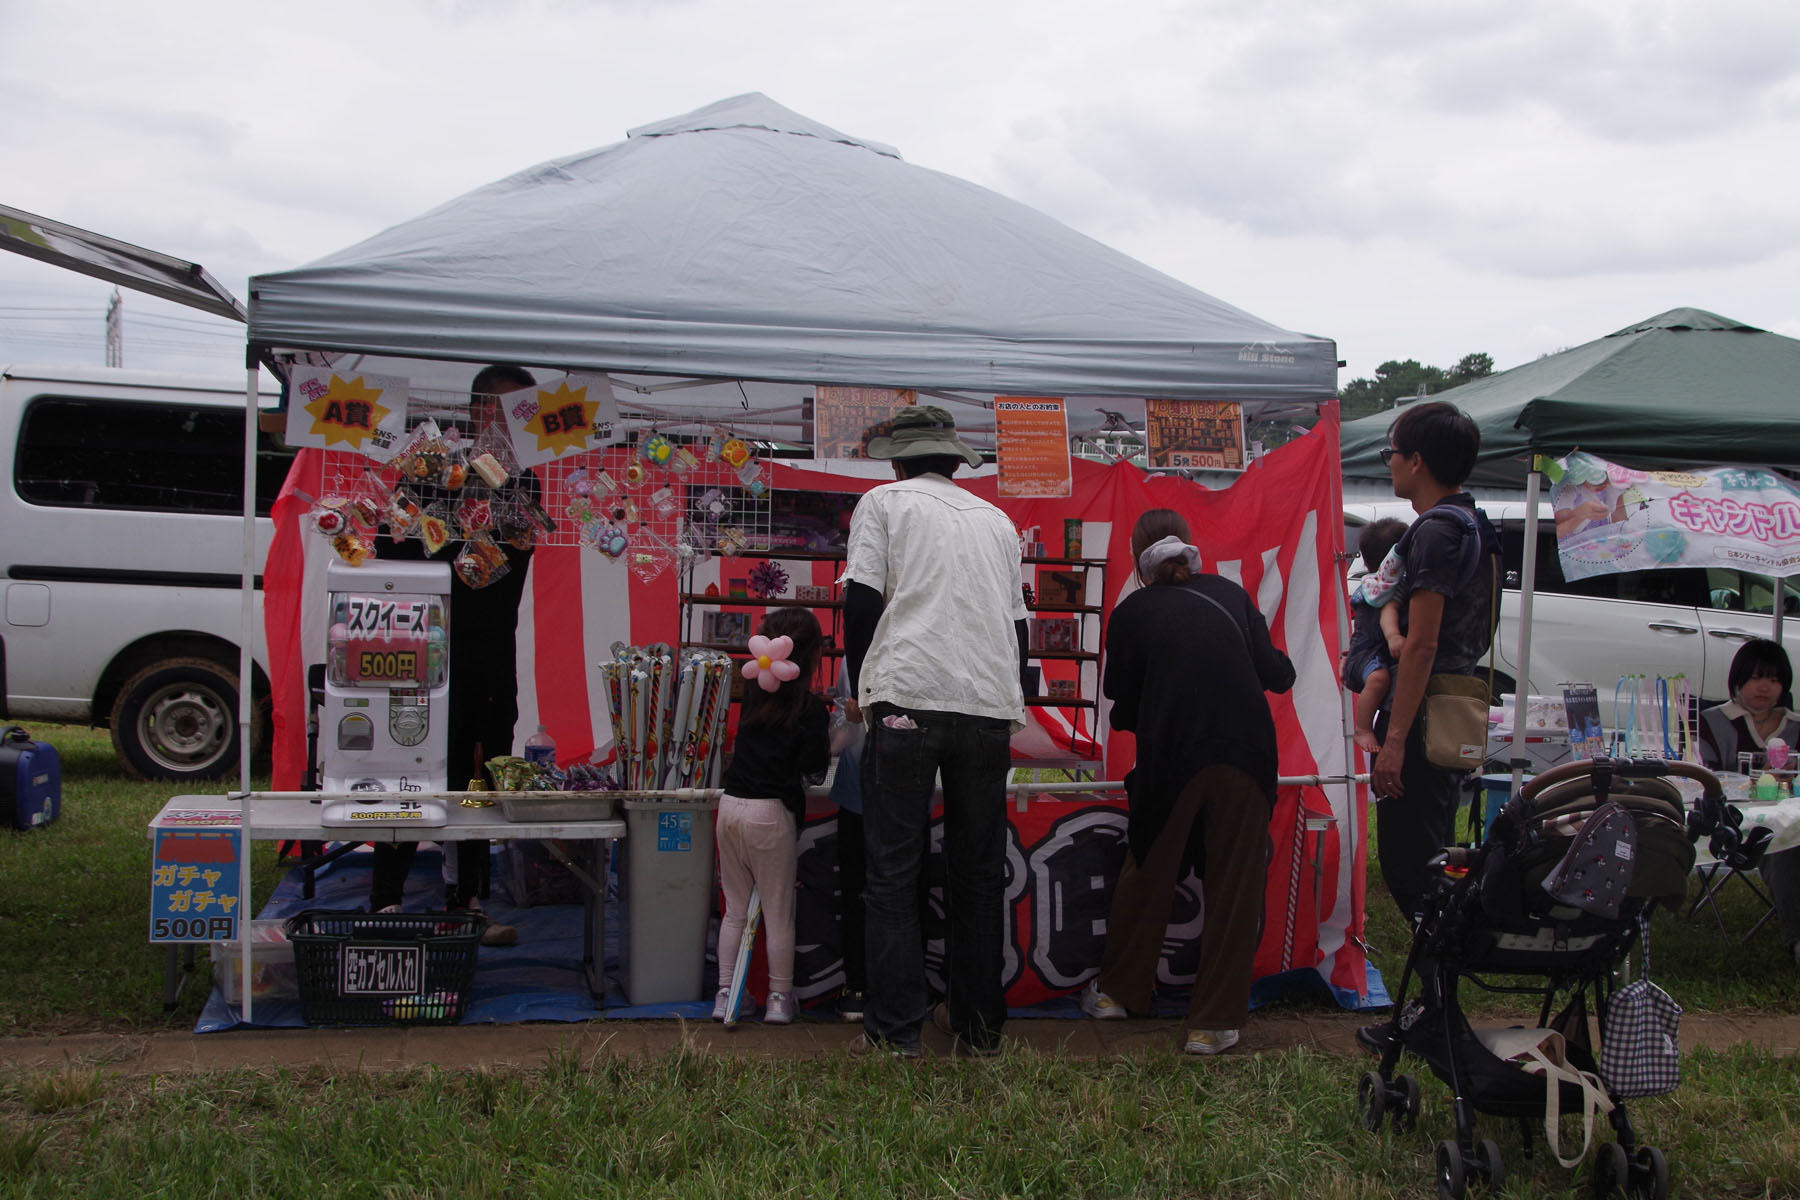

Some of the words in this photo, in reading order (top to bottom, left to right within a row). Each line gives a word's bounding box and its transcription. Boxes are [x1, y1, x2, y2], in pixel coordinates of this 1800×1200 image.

[323, 400, 372, 430] A賞
[542, 403, 587, 435] B賞
[349, 601, 427, 633] スクイーズ
[360, 651, 417, 679] 500円
[660, 815, 678, 828] 45
[154, 864, 222, 888] ガチャ
[168, 889, 238, 913] ガチャ
[154, 916, 233, 940] 500円
[348, 949, 415, 991] 空カプセル入れ
